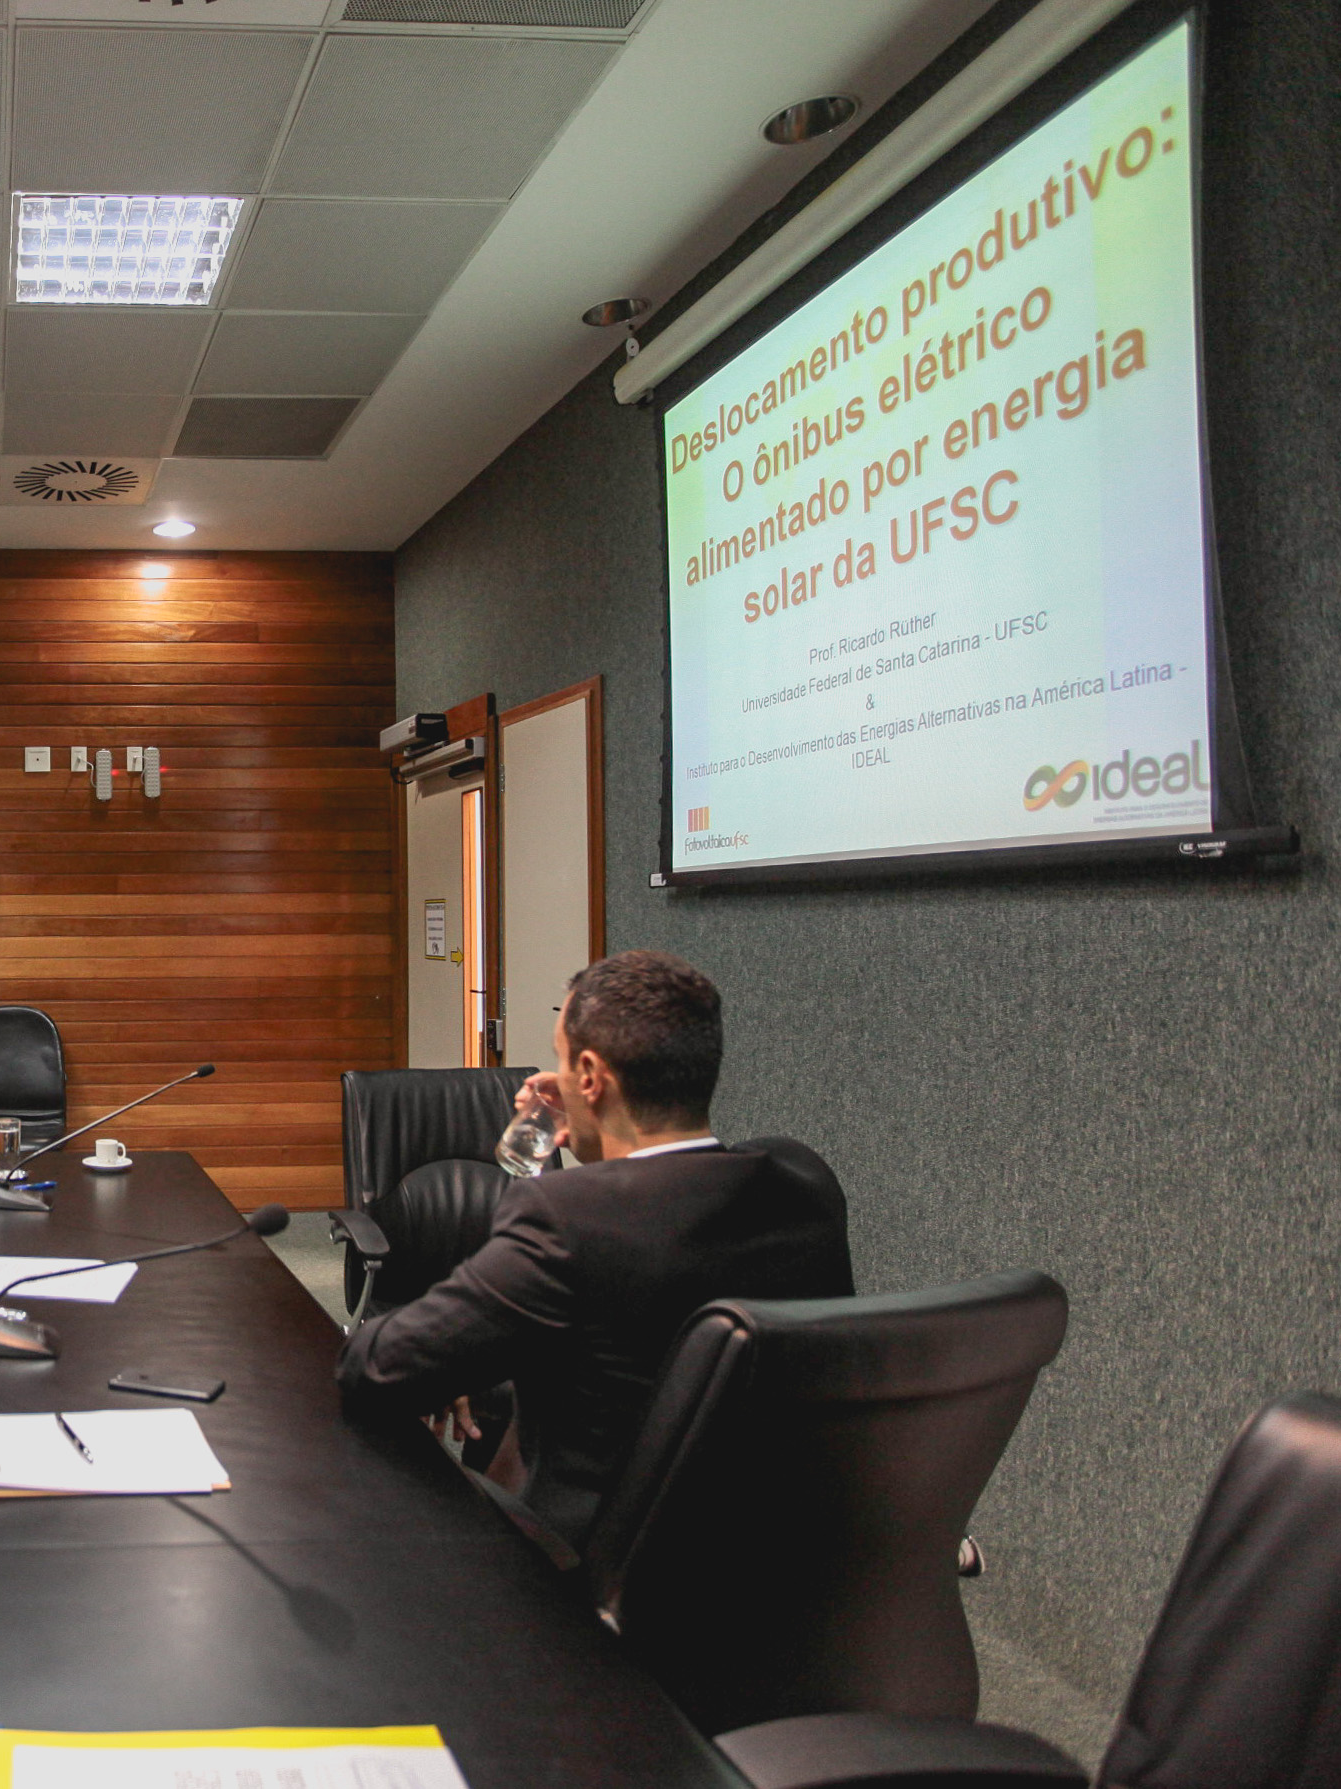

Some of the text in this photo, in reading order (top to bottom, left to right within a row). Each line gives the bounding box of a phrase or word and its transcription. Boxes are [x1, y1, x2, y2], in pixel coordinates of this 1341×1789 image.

[671, 105, 1175, 475] Deslocamento produtivo:
[722, 285, 1053, 502] O ônibus elétrico
[685, 327, 1147, 587] alimentado por energia
[743, 469, 1020, 624] solar da UFSC
[741, 683, 807, 713] Universidade
[809, 668, 852, 695] Federal
[855, 664, 872, 682] de
[875, 651, 915, 676] Santa
[918, 632, 981, 664] Catarina
[994, 611, 1048, 641] UFSC
[809, 612, 937, 665] Prof. Ricardo Rüther
[686, 761, 719, 780] Instituto
[719, 757, 739, 776] para
[739, 755, 746, 768] o
[748, 734, 834, 766] Desenvolvimento
[836, 729, 857, 748] das
[860, 716, 915, 743] Energias
[917, 697, 1001, 731] Alternativas
[1005, 693, 1027, 712] na
[1030, 676, 1105, 708] América
[1110, 662, 1172, 692] Latina
[865, 693, 875, 711] &
[851, 746, 891, 770] IDEAL
[1091, 738, 1209, 801] ideal
